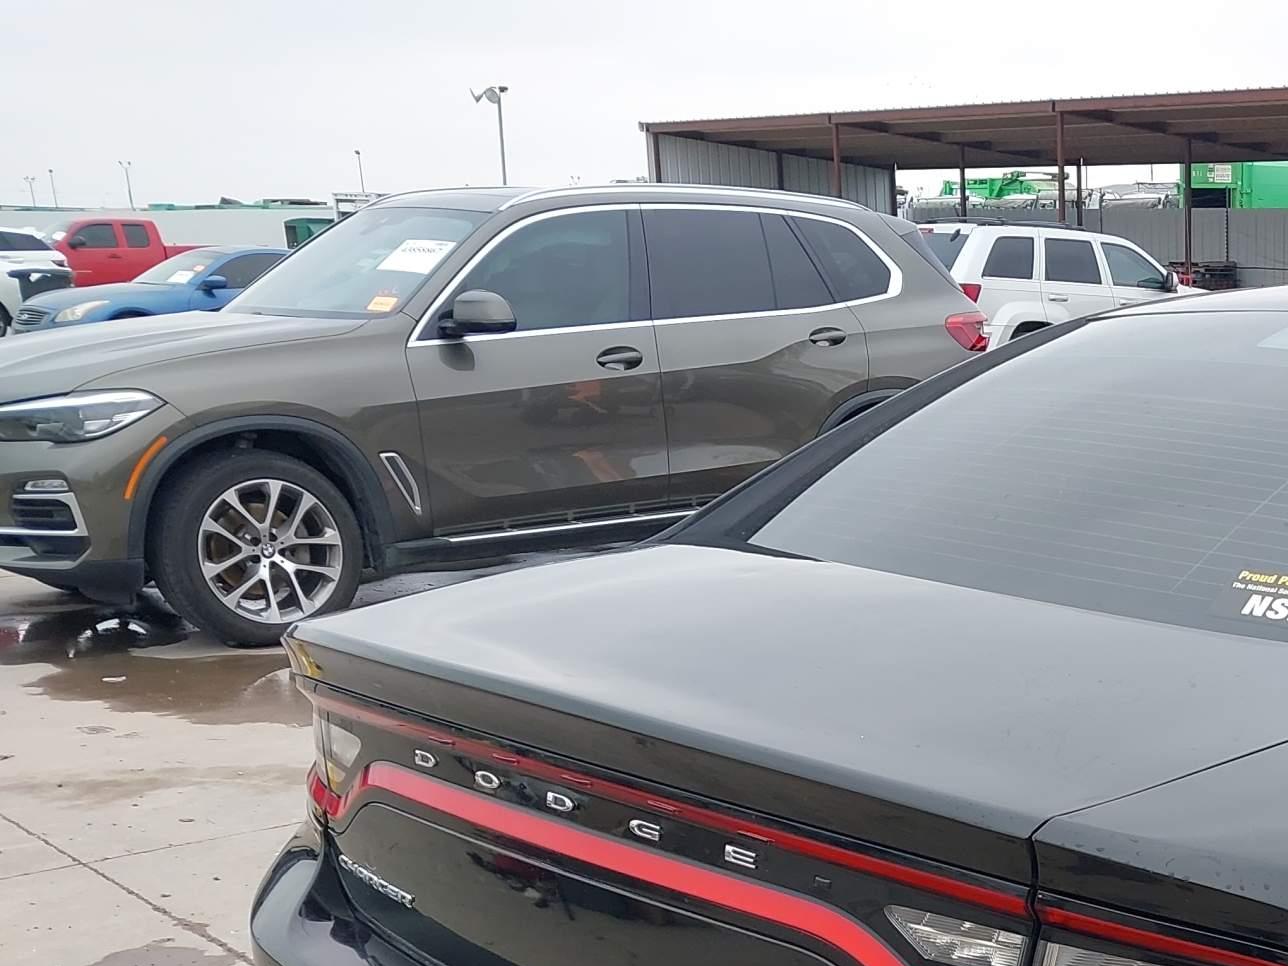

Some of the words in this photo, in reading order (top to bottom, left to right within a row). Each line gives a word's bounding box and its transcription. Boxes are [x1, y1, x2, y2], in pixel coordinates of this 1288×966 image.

[1232, 581, 1245, 590] The
[1246, 583, 1277, 594] National
[1238, 571, 1278, 584] Proud
[415, 750, 757, 869] DODGE
[338, 854, 415, 908] CHARGER
